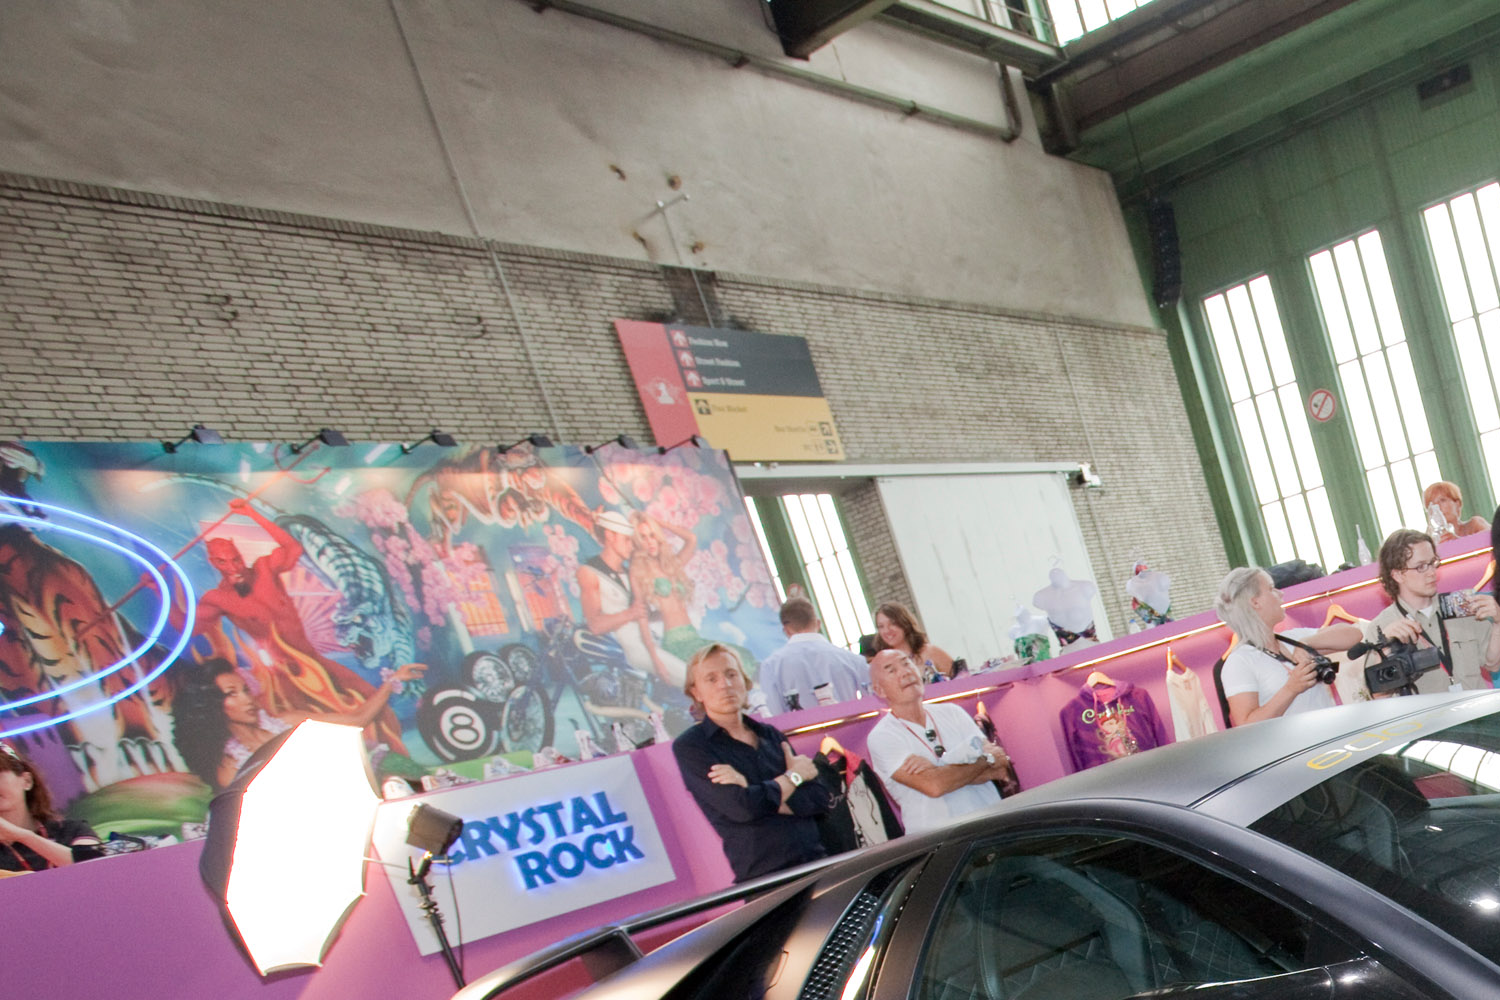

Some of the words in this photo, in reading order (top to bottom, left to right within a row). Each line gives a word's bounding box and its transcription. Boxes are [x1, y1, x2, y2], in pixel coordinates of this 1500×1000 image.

[450, 712, 480, 745] 8
[1306, 721, 1423, 770] edo
[513, 825, 645, 890] ROCK
